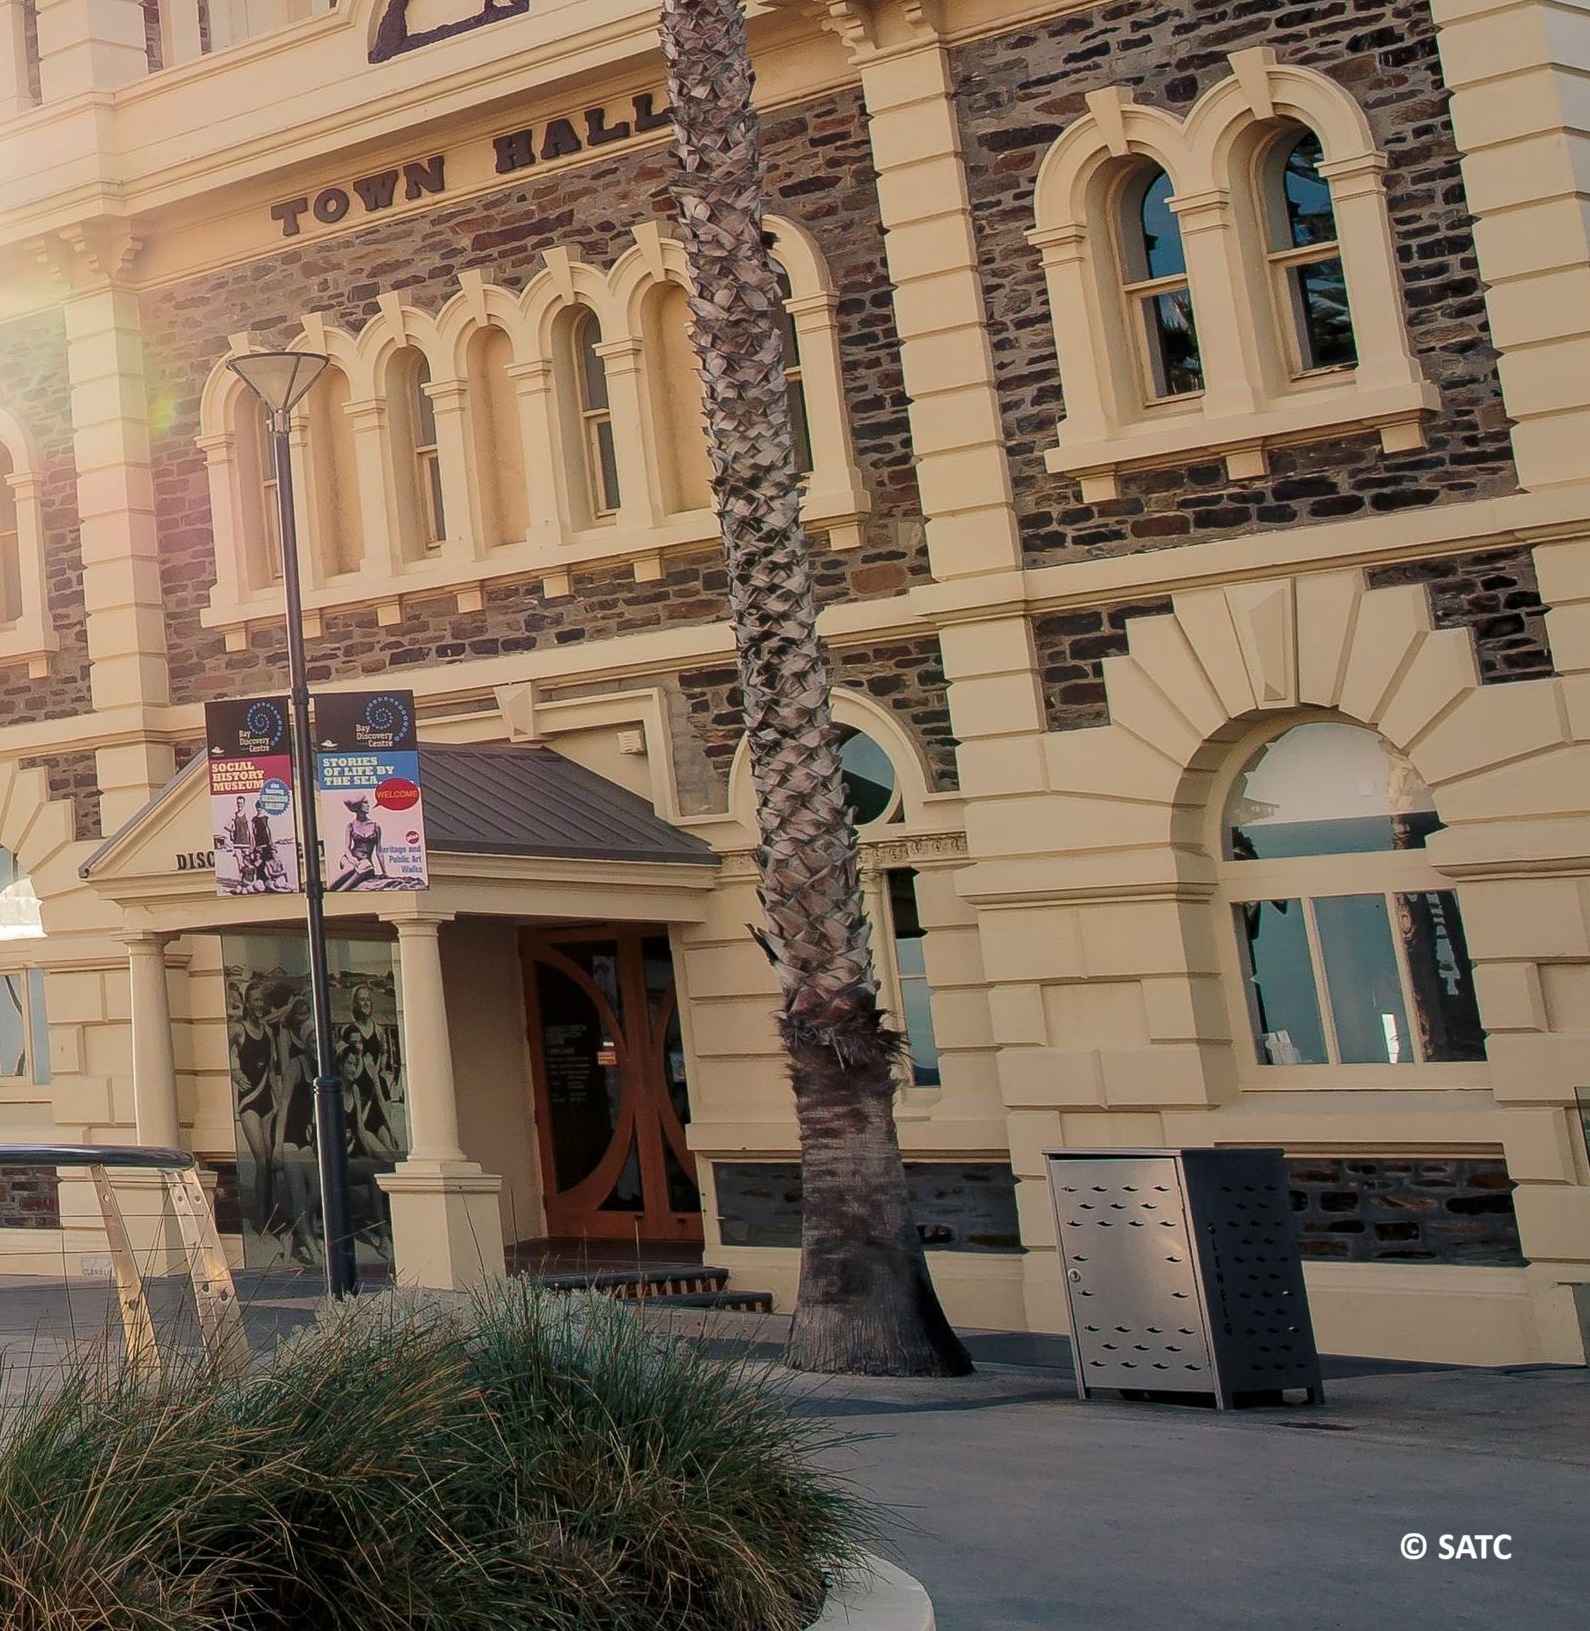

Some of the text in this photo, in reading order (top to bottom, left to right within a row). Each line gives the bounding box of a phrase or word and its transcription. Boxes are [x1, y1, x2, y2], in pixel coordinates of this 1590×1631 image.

[270, 93, 674, 237] TOWN HALL
[355, 724, 371, 733] Bay
[356, 732, 393, 741] Discovery
[212, 761, 254, 772] SOCIAL
[322, 757, 378, 767] STORIES
[212, 770, 264, 782] HISTORY
[323, 766, 395, 776] OF LIFE BY
[213, 780, 264, 791] MUSEUM
[324, 776, 350, 786] THE
[377, 790, 418, 798] WELCOME
[389, 855, 422, 863] Public Art
